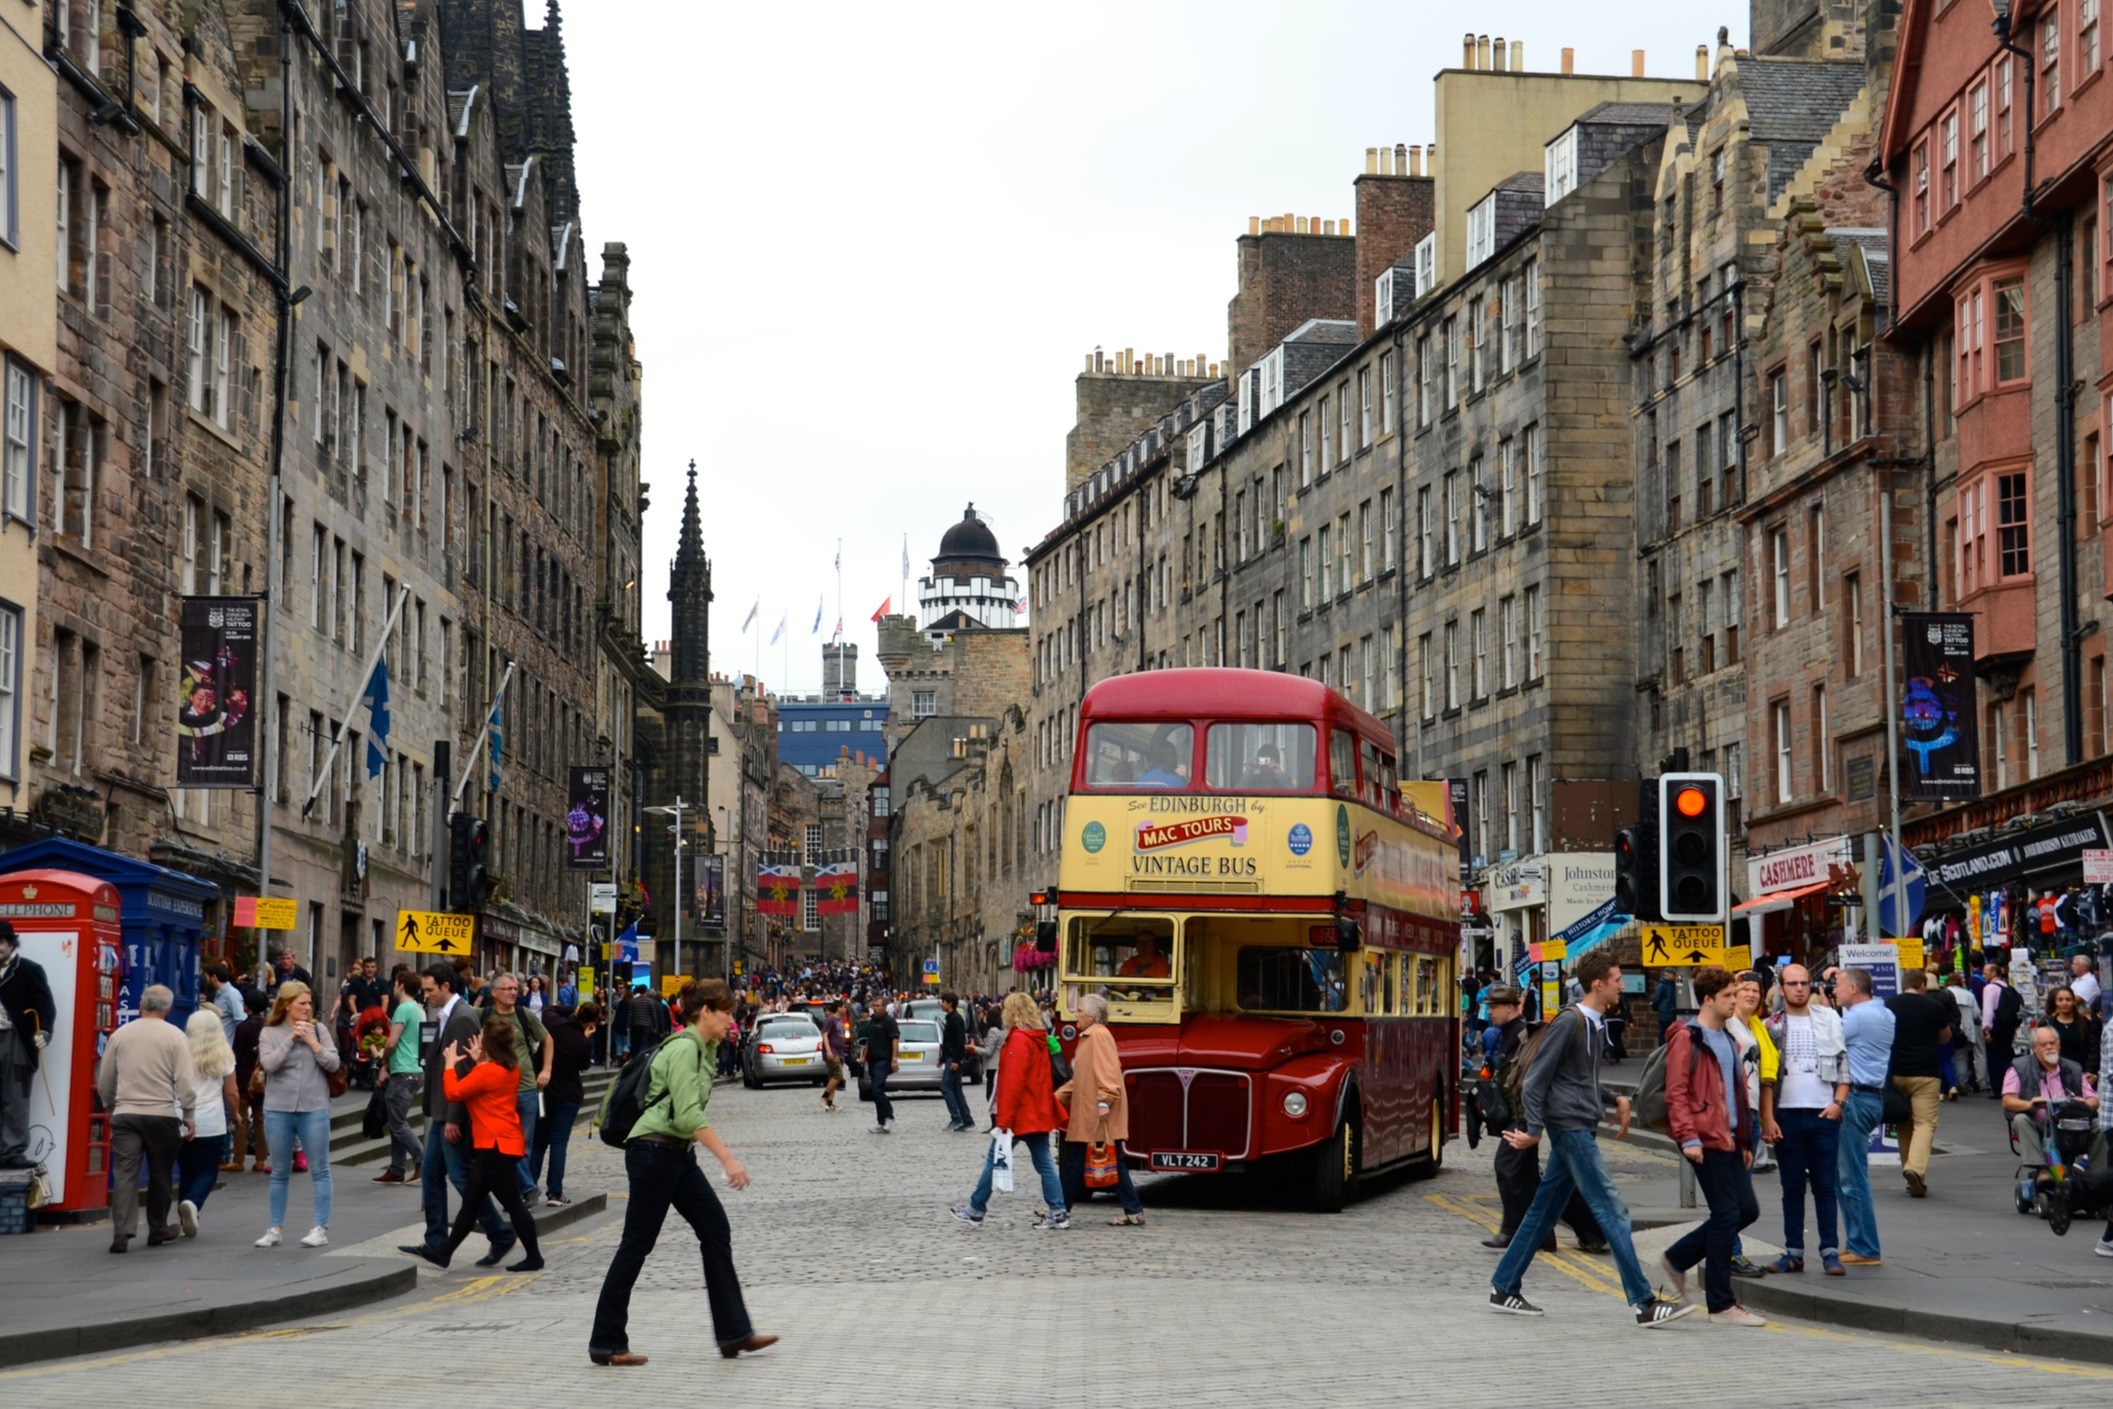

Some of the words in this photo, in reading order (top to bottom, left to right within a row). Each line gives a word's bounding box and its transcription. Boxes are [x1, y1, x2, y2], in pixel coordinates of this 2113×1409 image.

[1128, 801, 1147, 812] See
[1150, 797, 1247, 814] EDINBURGH
[1251, 800, 1265, 814] by
[1143, 826, 1178, 847] MAC
[1181, 817, 1233, 839] TOURS
[1132, 856, 1212, 875] VINTAGE
[1218, 857, 1257, 875] BUS
[1760, 854, 1815, 887] CASHMERE
[1494, 867, 1520, 889] CASH
[1563, 866, 1616, 882] Johnston
[1573, 882, 1616, 891] Cashmere
[0, 904, 71, 916] ELEPHONE
[173, 898, 202, 917] EXPERIENCE
[425, 915, 471, 927] TATTOO
[1567, 914, 1598, 936] HISTORIC
[1597, 900, 1617, 917] HOUS
[425, 926, 468, 938] QUEUE
[1671, 928, 1720, 938] TATTOO
[1673, 939, 1718, 948] QUEUE
[1846, 949, 1893, 958] Welcome!
[1162, 1155, 1183, 1166] VLT
[1186, 1156, 1208, 1167] 242
